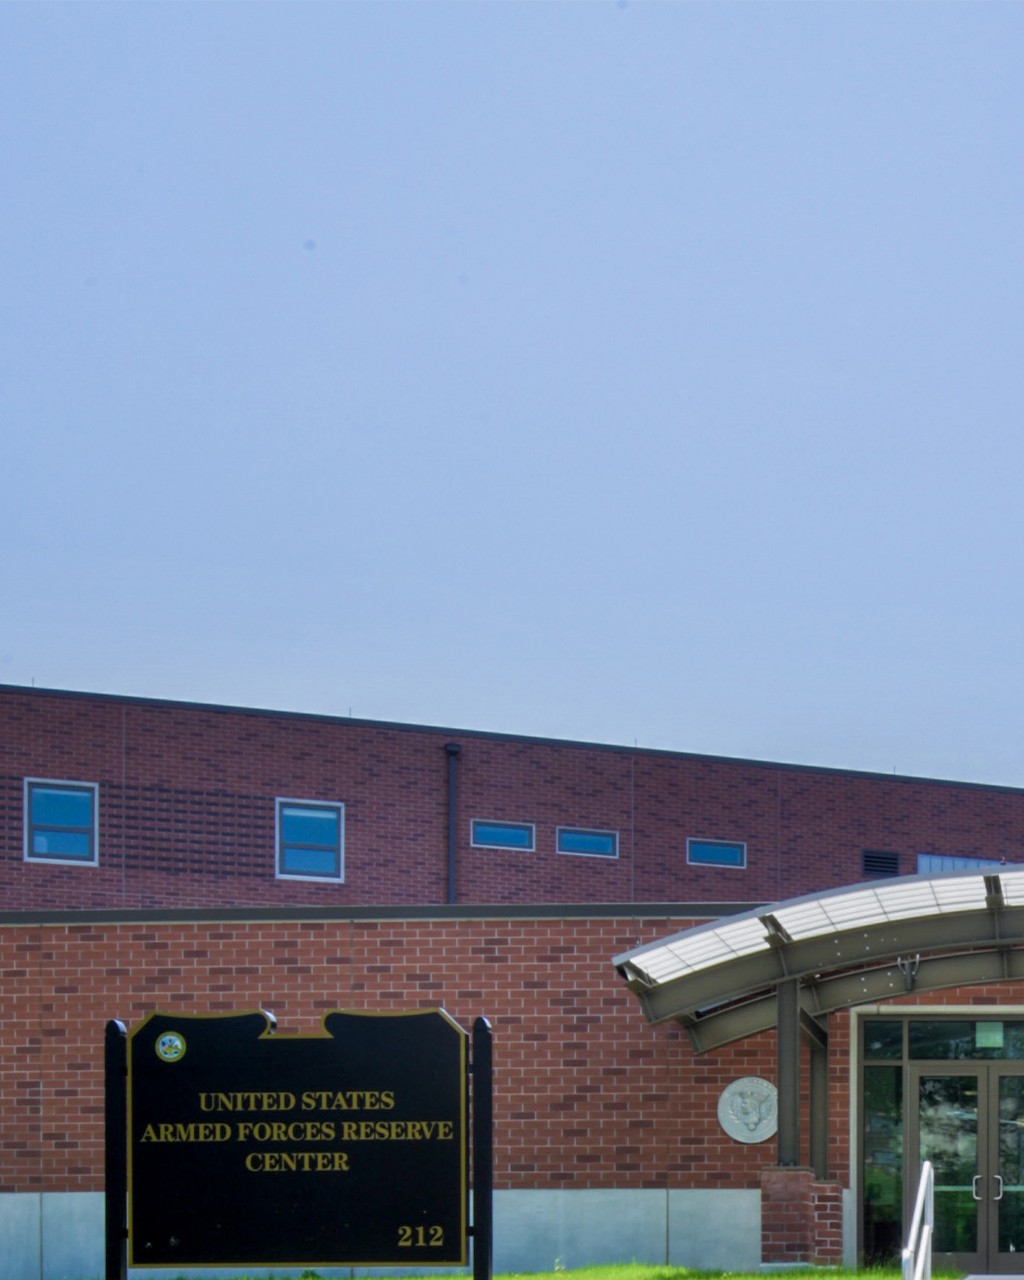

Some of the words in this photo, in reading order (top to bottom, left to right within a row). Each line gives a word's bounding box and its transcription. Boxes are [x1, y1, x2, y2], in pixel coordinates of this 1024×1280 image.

[199, 1091, 296, 1111] UNITED
[301, 1090, 395, 1110] STATES
[140, 1122, 232, 1142] ARMED
[237, 1122, 336, 1141] FORCES
[342, 1121, 453, 1140] RESERVE
[245, 1152, 350, 1171] CENTER
[398, 1225, 444, 1247] 212
